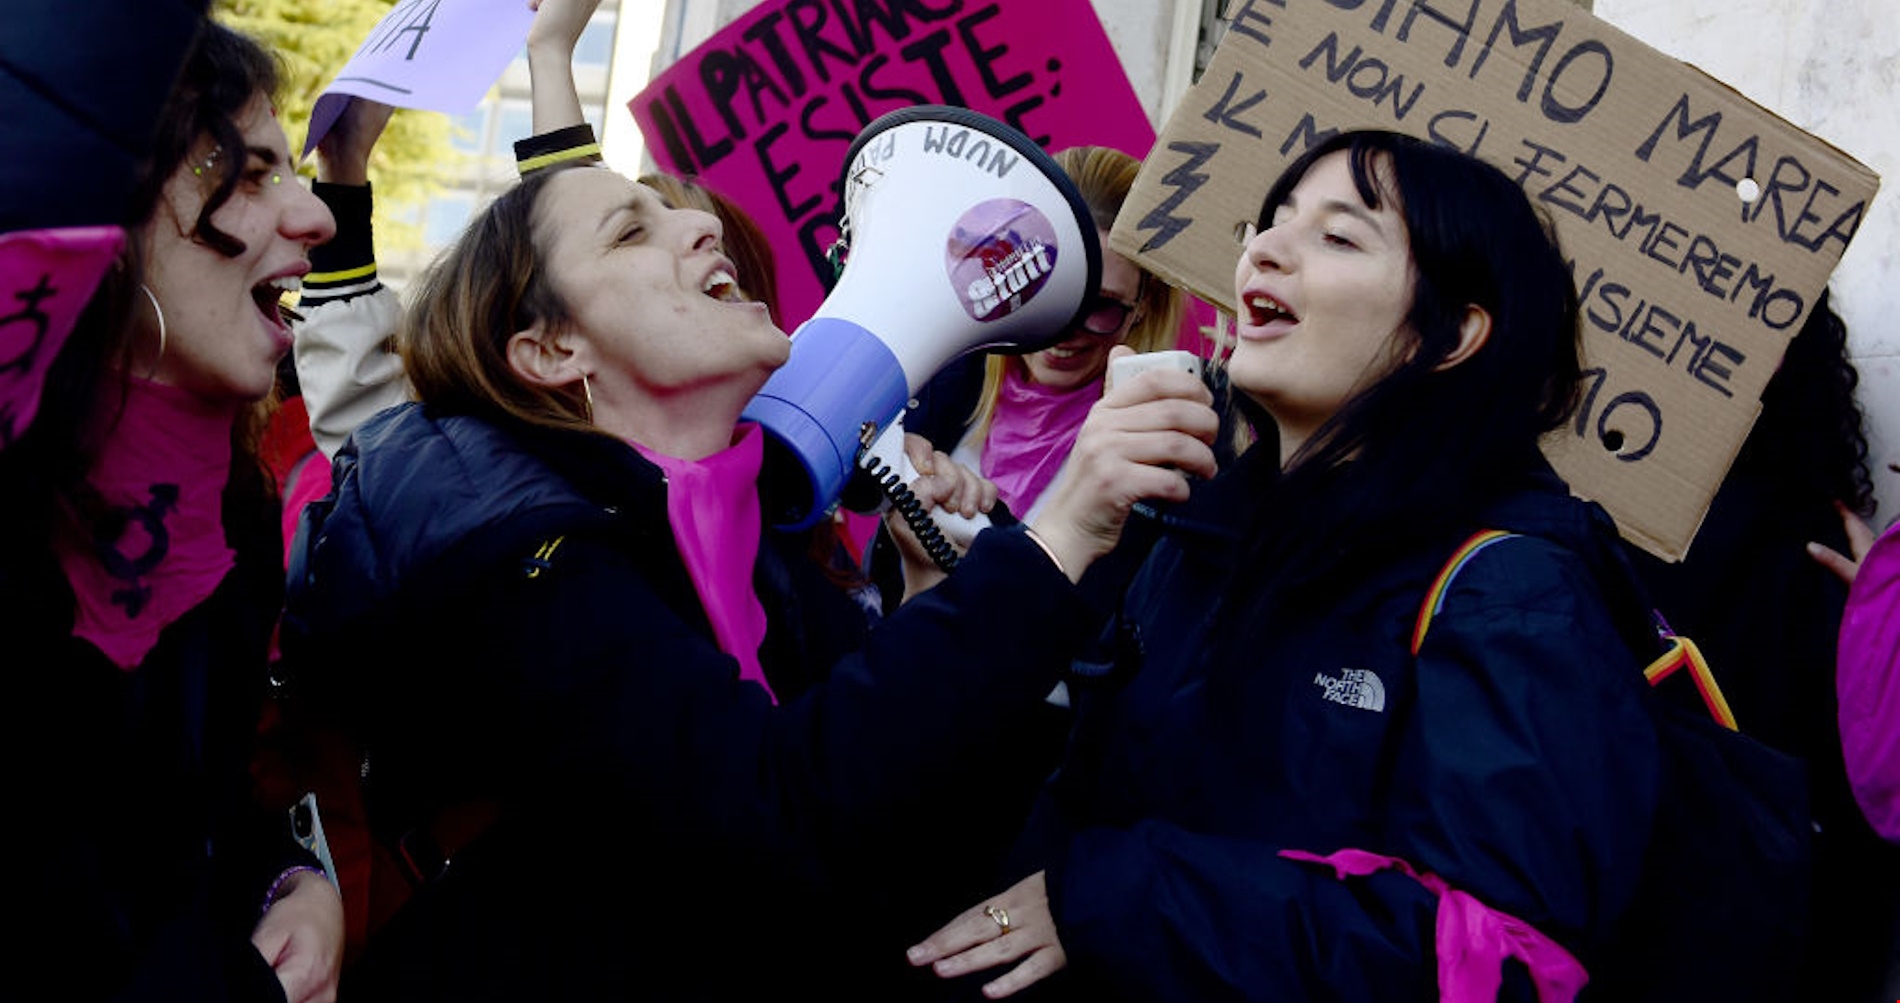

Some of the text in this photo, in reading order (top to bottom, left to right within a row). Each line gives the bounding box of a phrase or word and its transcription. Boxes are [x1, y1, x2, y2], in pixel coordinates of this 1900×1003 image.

[649, 83, 735, 178] IL
[923, 126, 1020, 180] NUDM
[1229, 0, 1287, 48] E
[1298, 31, 1426, 121] NON
[1513, 138, 1804, 331] FERMEREMO
[1634, 92, 1866, 253] MAREA
[1313, 672, 1361, 696] NORTH
[1322, 688, 1360, 708] FACE
[1341, 668, 1364, 683] THE
